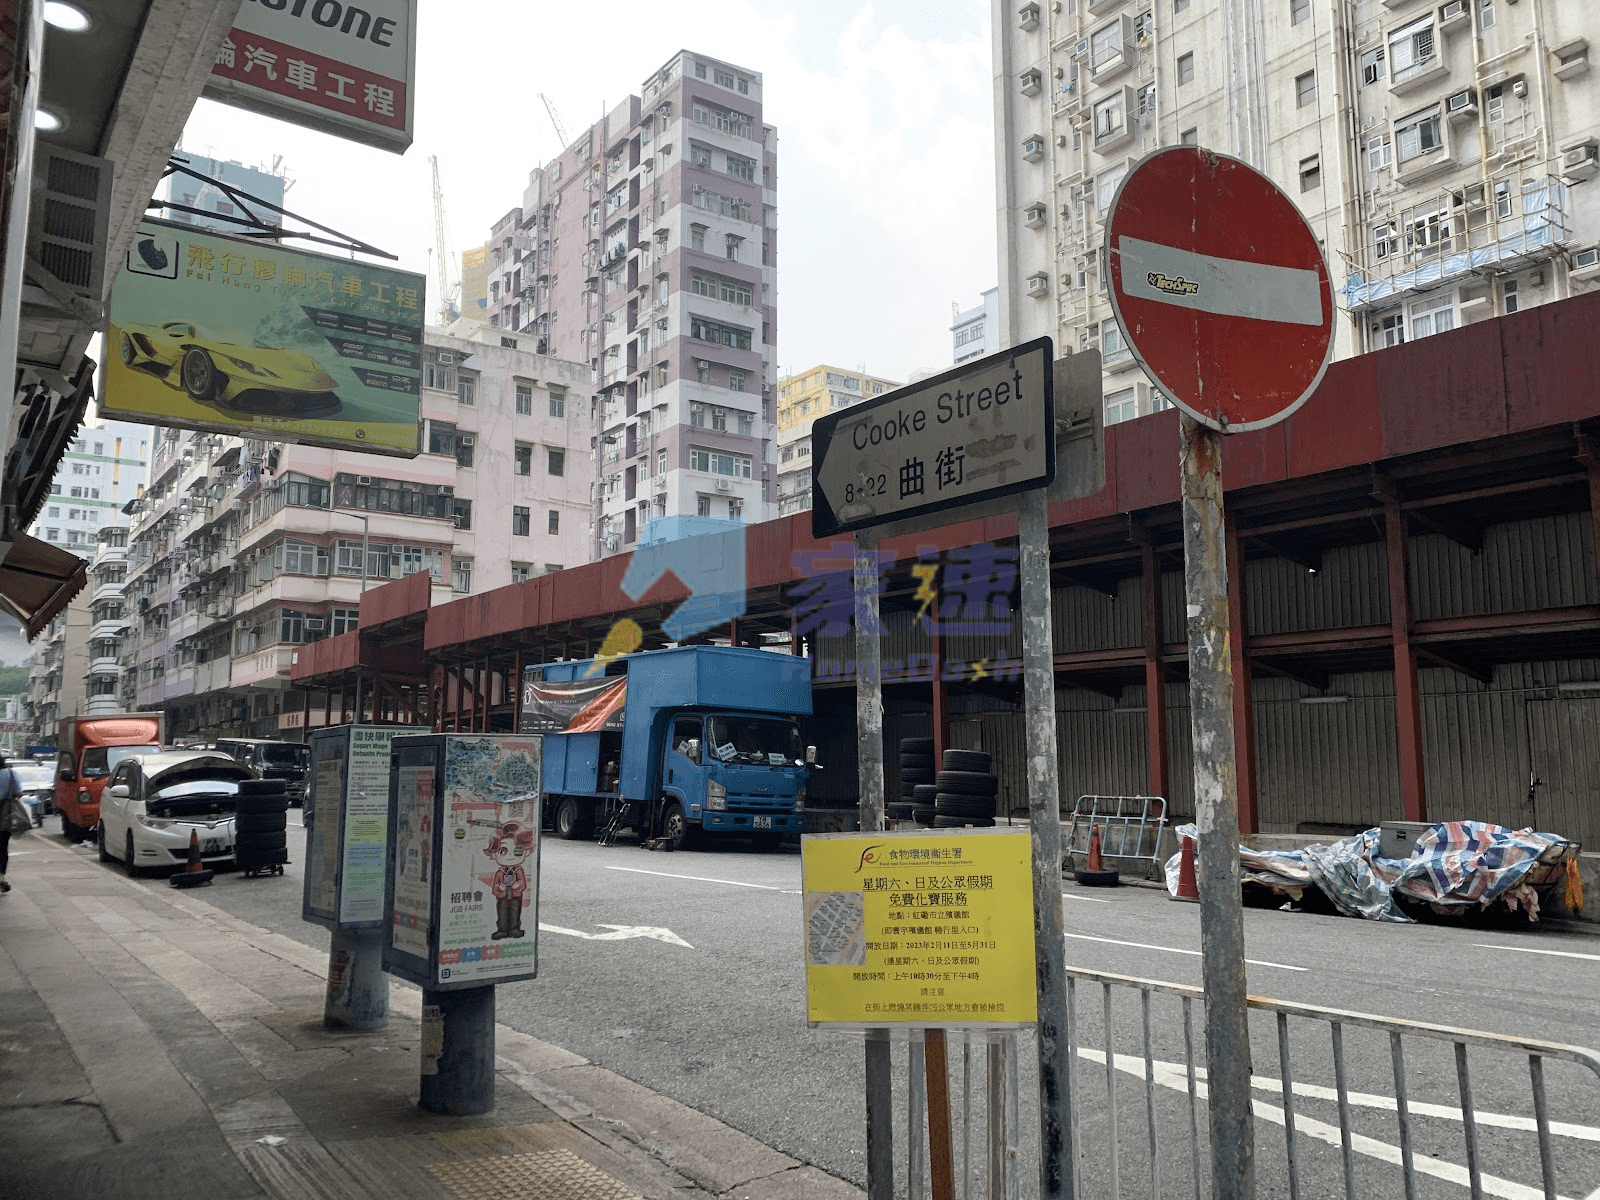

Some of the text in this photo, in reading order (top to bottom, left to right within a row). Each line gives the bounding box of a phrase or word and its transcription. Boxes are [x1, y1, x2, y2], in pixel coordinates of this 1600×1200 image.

[187, 243, 418, 310] 飛行膠輪汽車工程
[222, 276, 262, 293] Hang
[853, 369, 1023, 450] Cooke Street
[900, 446, 965, 499] 曲街
[353, 731, 416, 742] 盡快舉報
[863, 875, 993, 891] 星期六、日及公眾假期
[451, 891, 482, 903] 招聘會
[464, 904, 483, 912] FAIRS
